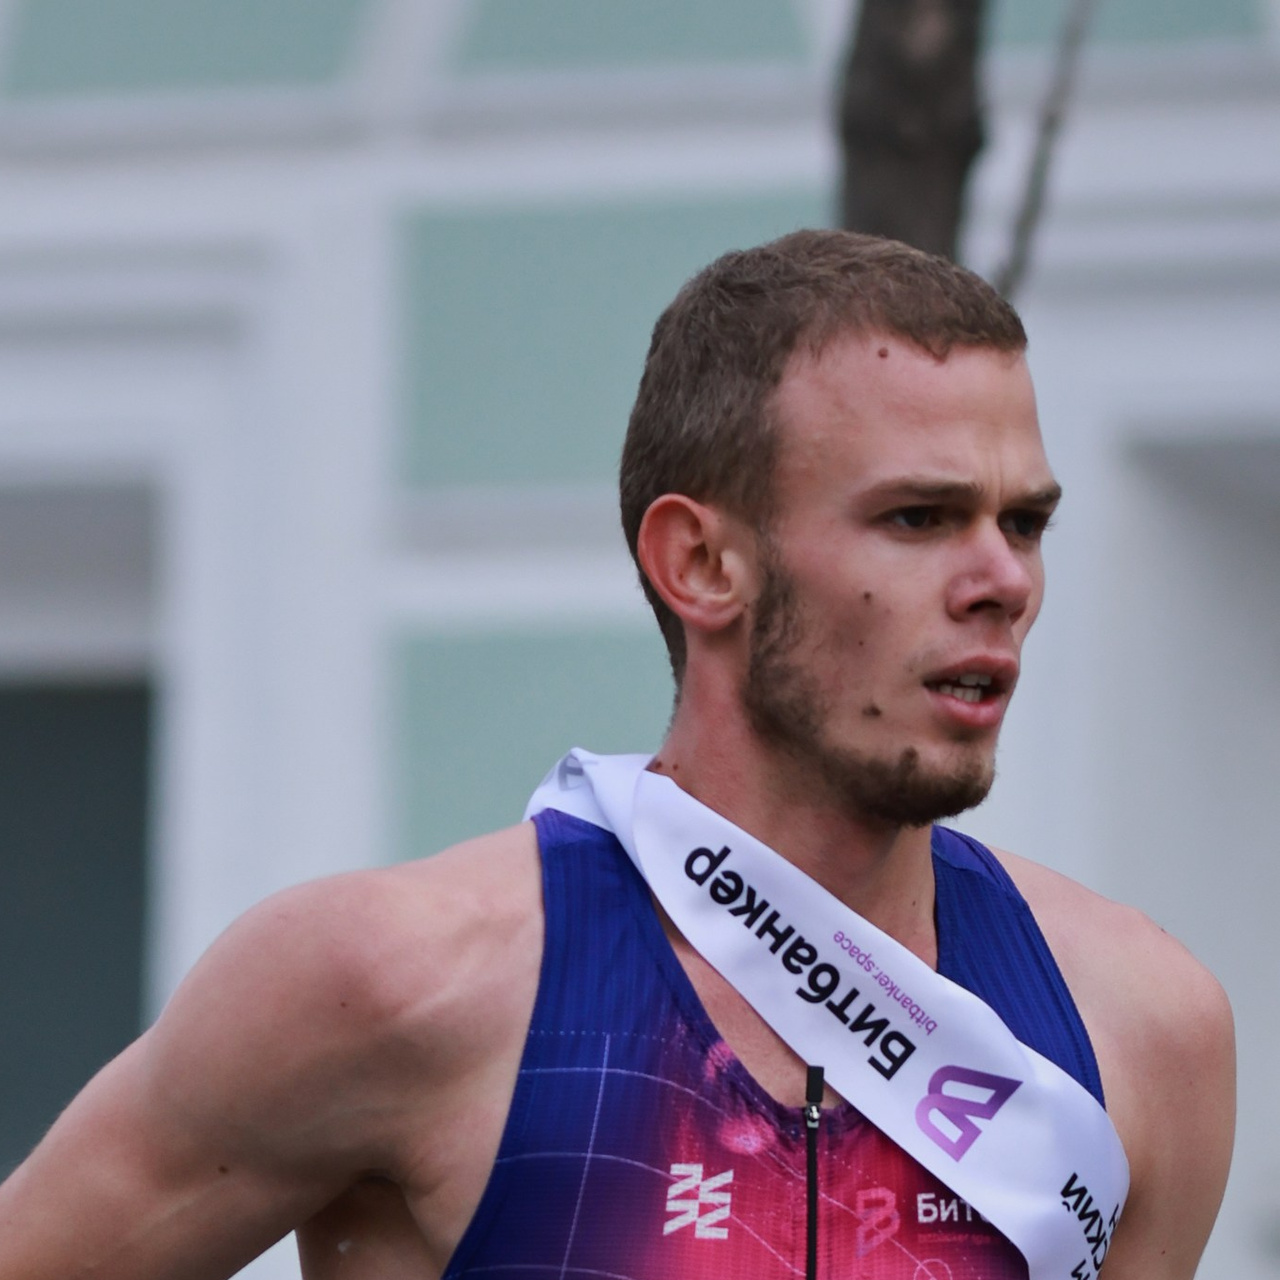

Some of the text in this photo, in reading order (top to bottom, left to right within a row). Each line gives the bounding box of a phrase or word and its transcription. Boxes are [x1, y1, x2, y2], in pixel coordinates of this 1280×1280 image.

[683, 845, 918, 1082] Битбанкер
[832, 928, 938, 1037] bitbanker.space
[916, 1192, 989, 1224] Бит
